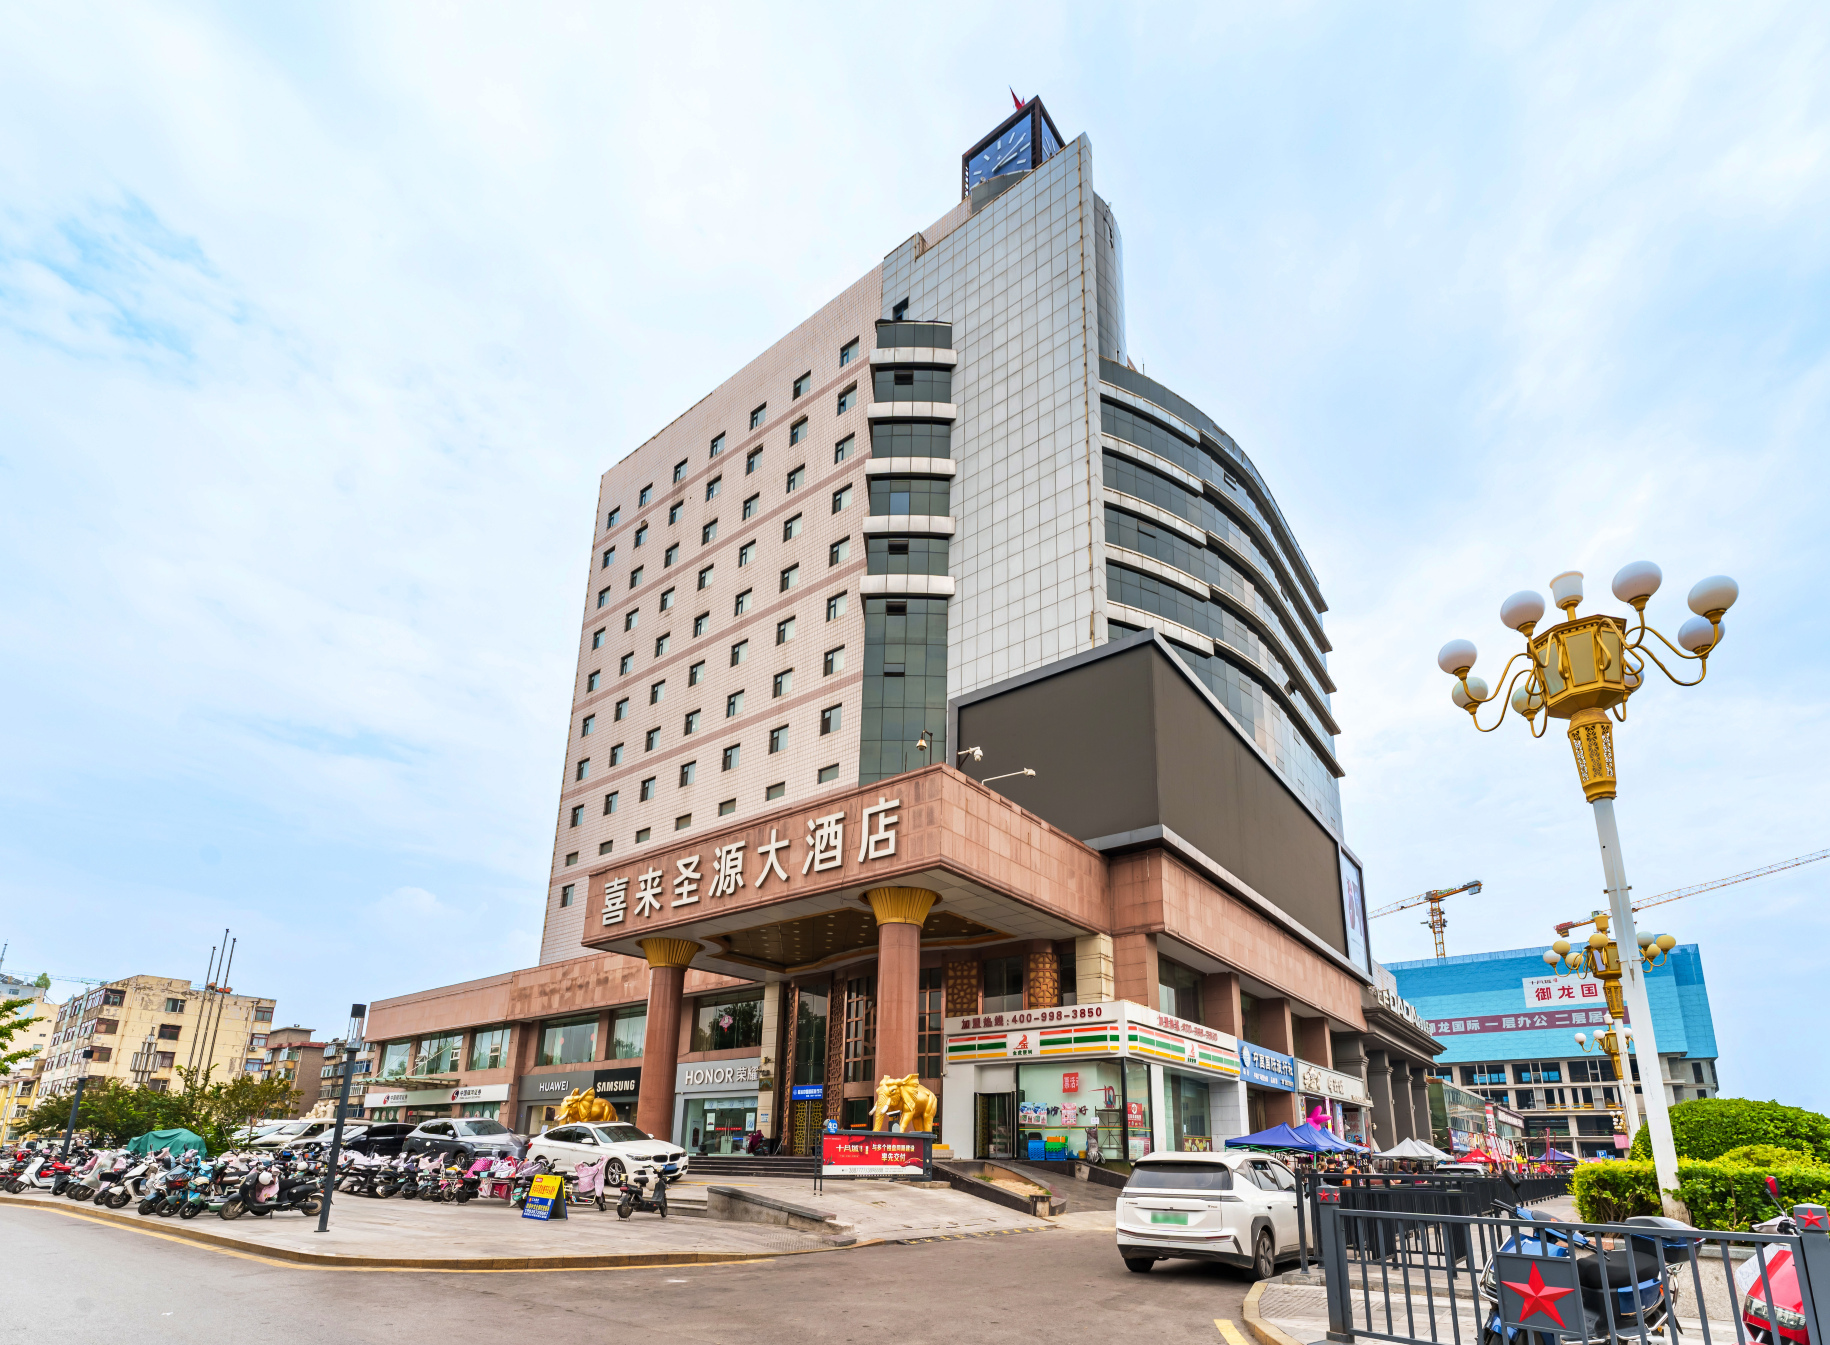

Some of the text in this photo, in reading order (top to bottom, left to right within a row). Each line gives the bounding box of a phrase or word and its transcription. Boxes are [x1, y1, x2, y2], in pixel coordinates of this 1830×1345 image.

[601, 797, 901, 926] 喜来圣源大酒店
[1555, 1010, 1609, 1025] 二层居
[1252, 1051, 1293, 1077] 中国国际旅行社
[685, 1066, 760, 1085] HONOR 荣耀
[539, 1080, 569, 1092] HUAWEI
[596, 1080, 635, 1093] SAMSUNG
[881, 1152, 906, 1162] 率先交付
[1598, 1151, 1605, 1159] P
